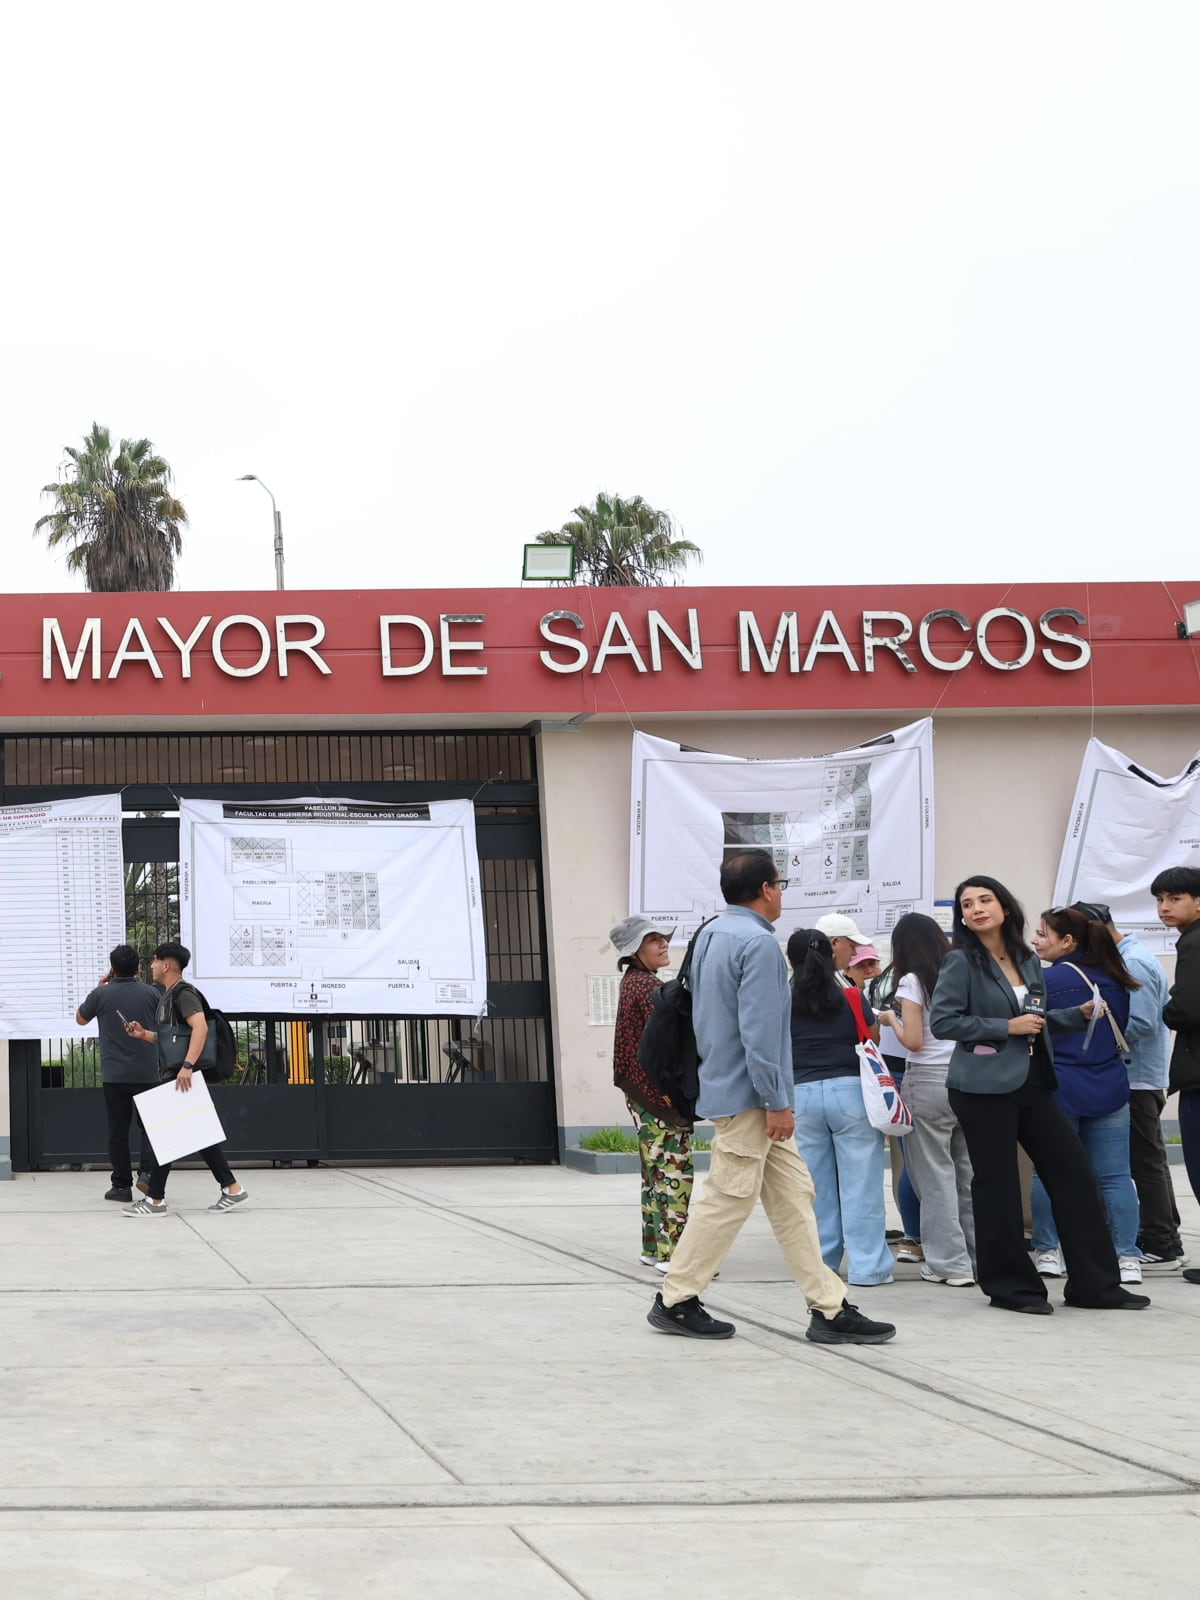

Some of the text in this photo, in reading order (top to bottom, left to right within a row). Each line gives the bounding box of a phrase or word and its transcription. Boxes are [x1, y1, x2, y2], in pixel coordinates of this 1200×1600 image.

[42, 614, 333, 680] MAYOR
[379, 613, 489, 677] DE
[539, 608, 703, 674] SAN
[738, 607, 1092, 673] MARCOS
